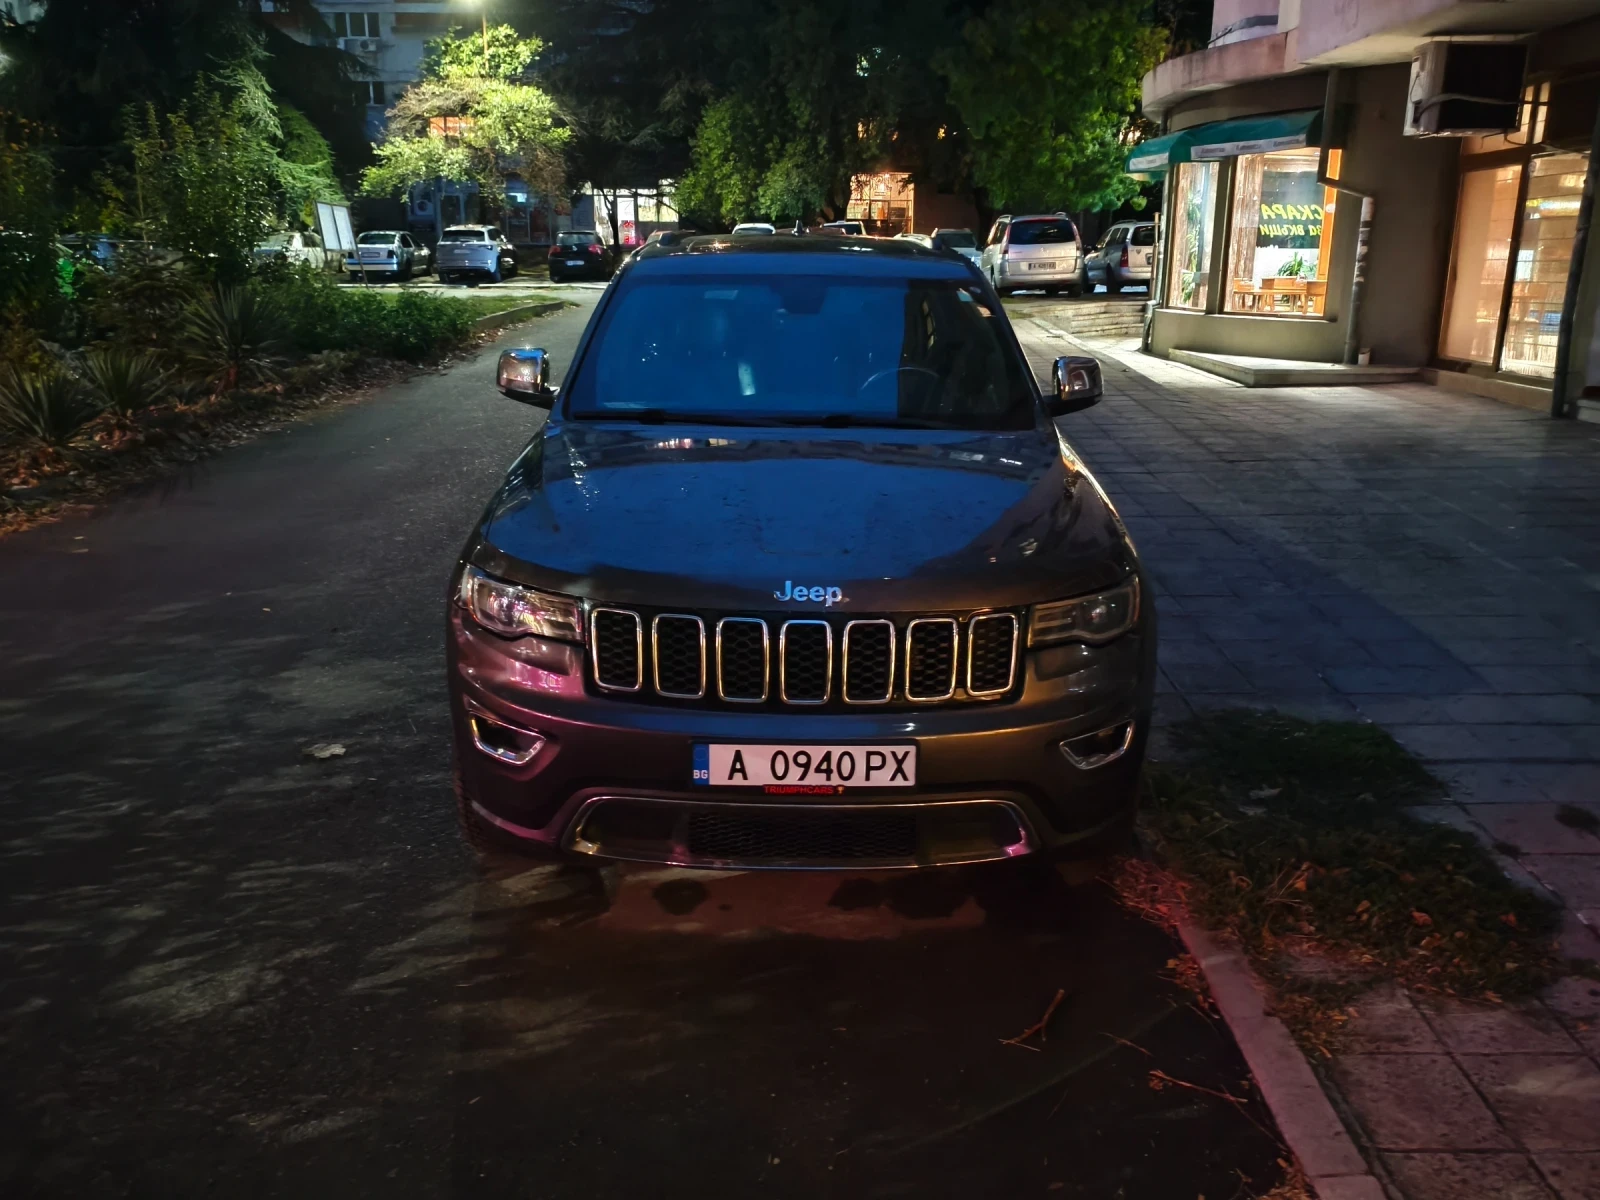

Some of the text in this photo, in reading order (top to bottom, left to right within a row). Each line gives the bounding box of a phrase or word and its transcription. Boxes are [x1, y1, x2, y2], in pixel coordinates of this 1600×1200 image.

[774, 580, 842, 607] Jeep
[693, 770, 708, 779] BG
[727, 749, 910, 782] A 0940 PX
[763, 785, 834, 794] TRIUMPHCARS
